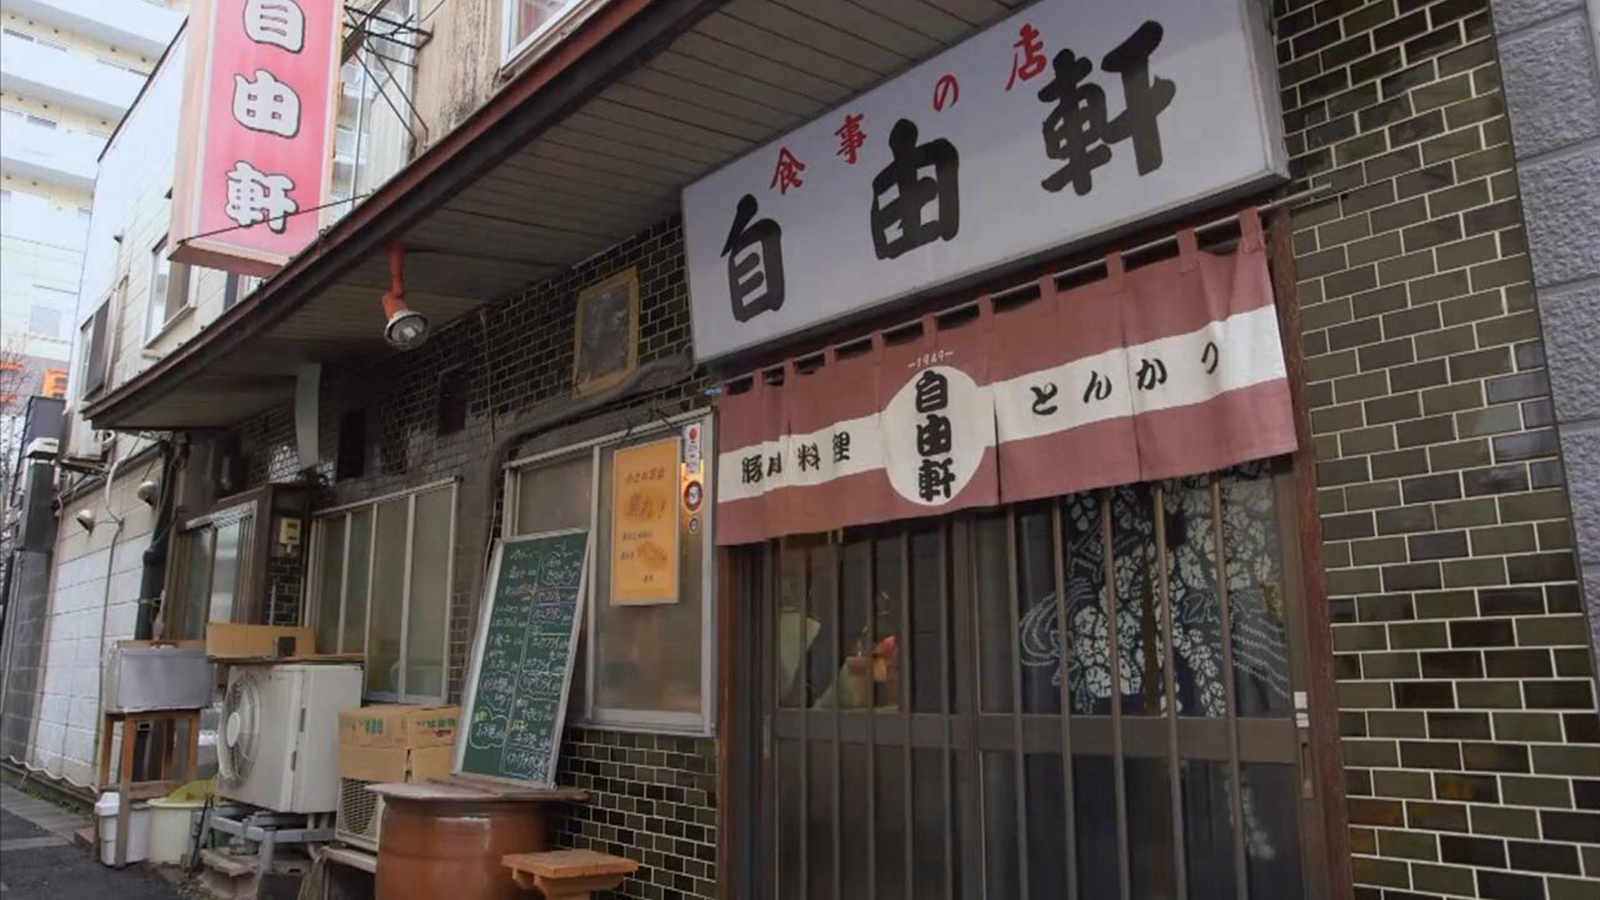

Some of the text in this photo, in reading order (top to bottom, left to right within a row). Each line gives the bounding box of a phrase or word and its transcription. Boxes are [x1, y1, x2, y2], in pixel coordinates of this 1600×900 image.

[225, 0, 306, 235] 自由軒
[720, 20, 1177, 324] 自由軒
[770, 23, 1048, 197] 食事の店
[915, 370, 956, 502] 自由軒
